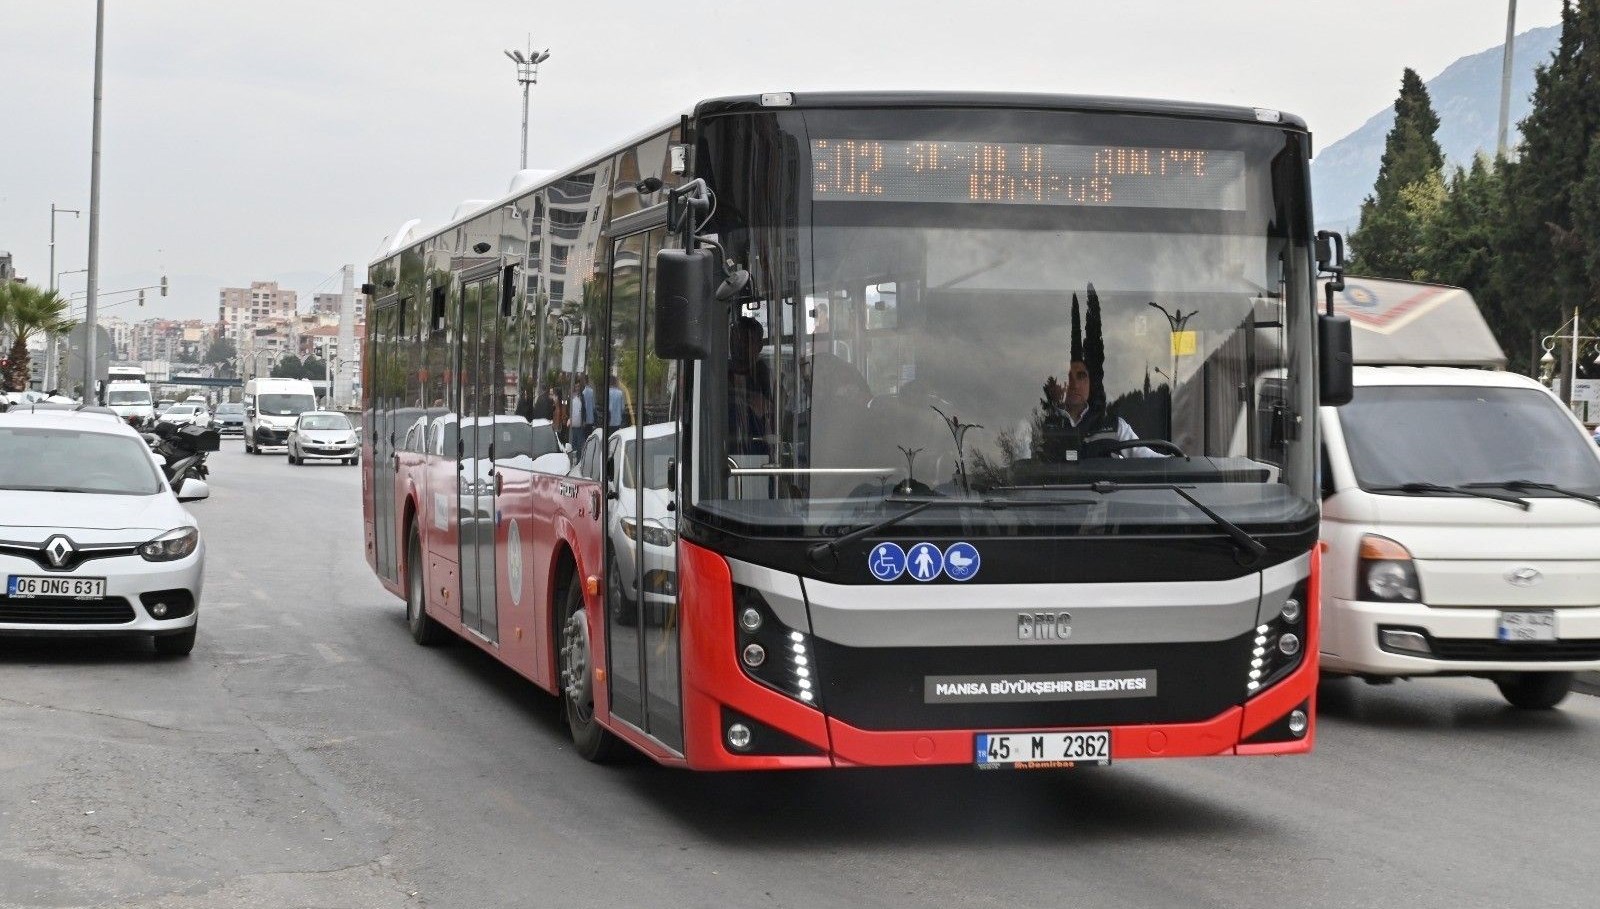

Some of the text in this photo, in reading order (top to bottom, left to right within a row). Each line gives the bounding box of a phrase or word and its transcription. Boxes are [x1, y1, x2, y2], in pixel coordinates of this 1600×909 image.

[18, 579, 36, 592] 06
[41, 580, 69, 593] DNG
[74, 581, 101, 594] 631
[936, 677, 1147, 696] MANİSA BÜYÜKŞEHİR BELEDİYESİ
[988, 735, 1107, 760] 45 M 2362
